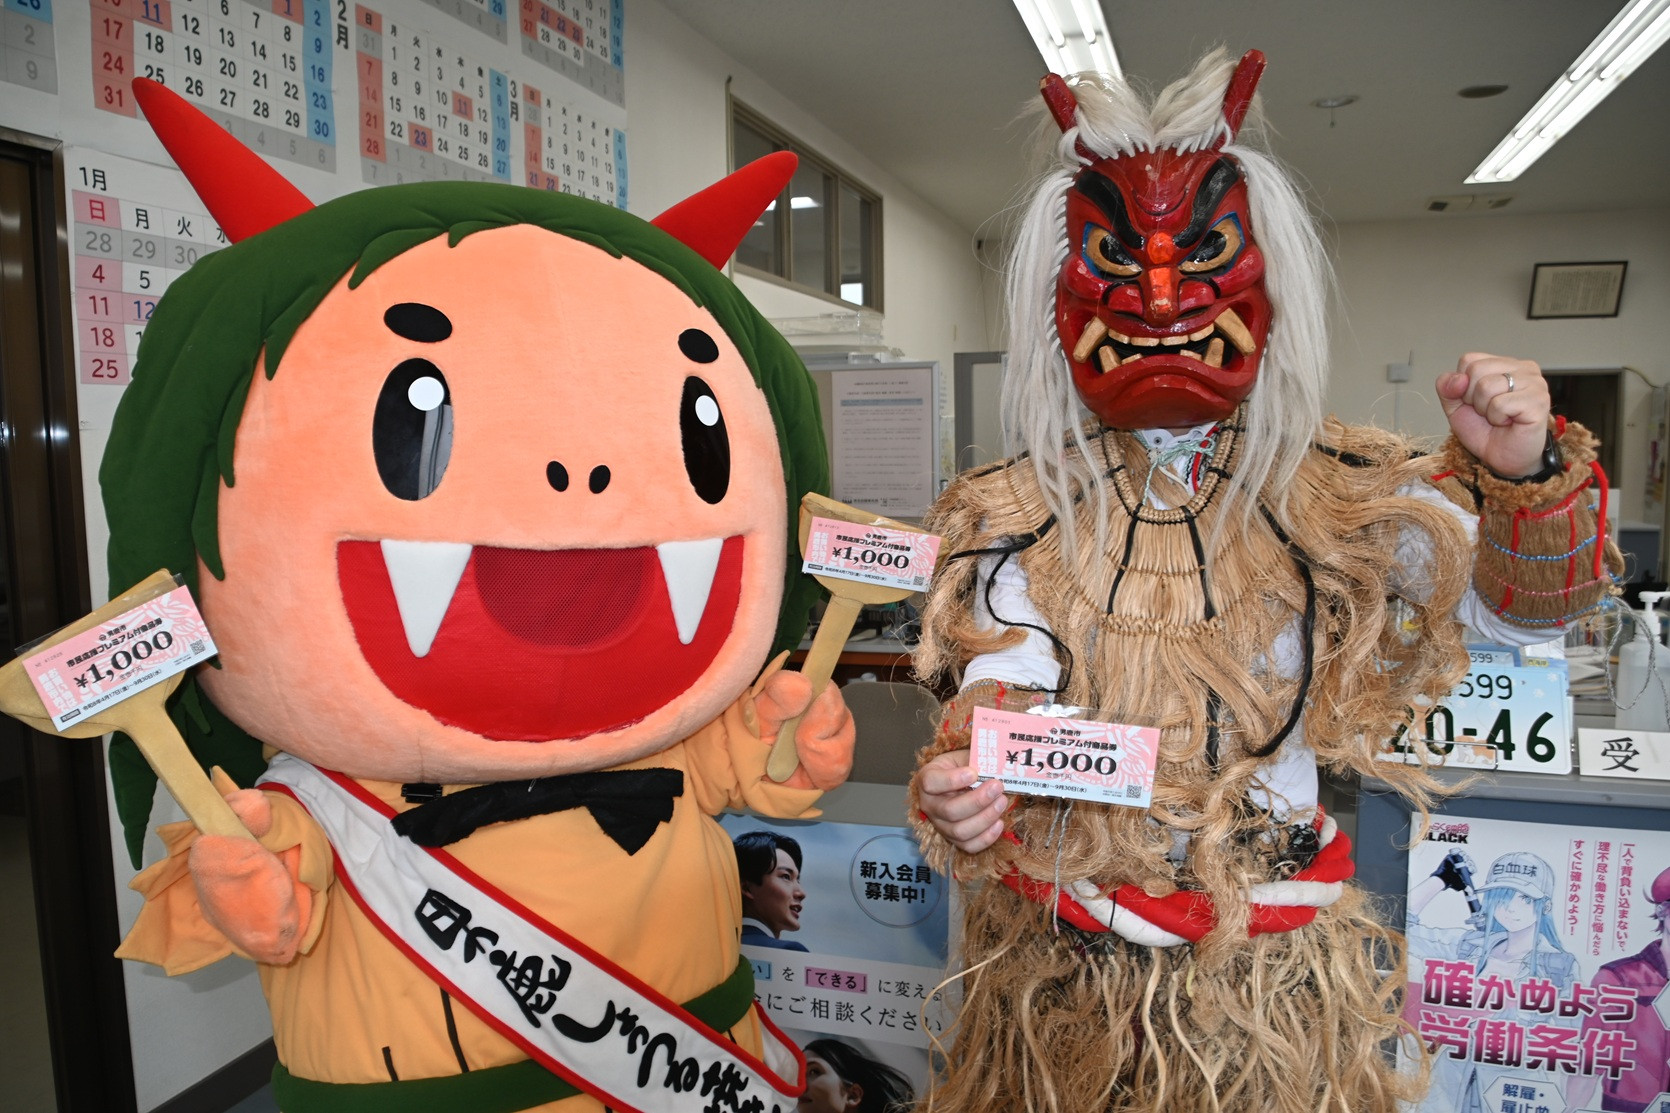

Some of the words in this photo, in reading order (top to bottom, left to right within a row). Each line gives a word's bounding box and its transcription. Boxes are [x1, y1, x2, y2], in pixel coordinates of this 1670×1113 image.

[314, 10, 321, 27] 2
[24, 24, 35, 46] 2
[252, 11, 260, 29] 7
[283, 25, 291, 42] 8
[315, 38, 322, 53] 9
[182, 14, 200, 36] 12
[219, 27, 235, 48] 13
[251, 40, 267, 60] 14
[282, 52, 296, 72] 15
[311, 64, 325, 83] 16
[26, 60, 38, 80] 9
[103, 17, 123, 40] 17
[145, 32, 164, 54] 18
[184, 45, 203, 66] 19
[219, 57, 237, 78] 20
[252, 69, 268, 90] 21
[283, 80, 299, 101] 22
[312, 92, 327, 110] 23
[392, 46, 396, 61] 1
[414, 56, 420, 72] 2
[437, 66, 443, 81] 3
[459, 76, 465, 90] 4
[479, 85, 484, 99] 5
[103, 51, 124, 75] 24
[145, 64, 165, 85] 25
[185, 76, 204, 97] 26
[219, 88, 236, 108] 27
[252, 99, 270, 119] 28
[285, 109, 300, 129] 29
[314, 119, 329, 138] 30
[104, 86, 123, 108] 31
[391, 71, 398, 86] 8
[414, 81, 421, 96] 9
[436, 89, 448, 106] 10
[478, 107, 487, 123] 12
[510, 80, 519, 122] 3月
[390, 95, 402, 113] 15
[413, 105, 426, 122] 16
[437, 113, 448, 129] 17
[459, 122, 469, 137] 18
[479, 130, 488, 145] 19
[563, 123, 568, 136] 2
[365, 112, 377, 129] 21
[390, 121, 403, 138] 22
[414, 128, 427, 147] 23
[437, 138, 449, 154] 24
[458, 146, 469, 161] 25
[478, 153, 489, 168] 26
[366, 138, 379, 155] 28
[546, 157, 555, 170] 15
[562, 163, 571, 176] 16
[577, 169, 585, 182] 17
[591, 175, 599, 188] 18
[606, 181, 614, 193] 19
[577, 149, 585, 162] 10
[591, 155, 598, 168] 11
[604, 162, 612, 175] 12
[79, 166, 107, 191] 1月
[89, 199, 106, 222] 日
[135, 208, 150, 229] 月
[177, 216, 193, 238] 火
[85, 231, 112, 253] 28
[132, 238, 156, 259] 29
[174, 245, 198, 265] 30
[91, 264, 105, 284] 4
[139, 270, 151, 289] 5
[89, 295, 109, 316] 11
[133, 300, 156, 320] 12
[90, 327, 115, 348] 18
[91, 359, 118, 379] 25
[832, 546, 910, 570] ¥1,000
[73, 630, 174, 688] ¥1,000
[1008, 732, 1118, 751] 市民応援プレミアム付商品券
[1059, 729, 1082, 737] 男鹿市
[1005, 748, 1117, 776] ¥1,000
[1600, 737, 1641, 773] 受
[1424, 831, 1469, 845] LACK
[860, 860, 932, 886] 新入会員
[1493, 862, 1538, 878] 白血球
[864, 881, 926, 905] 募集中!
[1592, 841, 1611, 956] 理不尽な働き方に悩んだら
[1421, 958, 1638, 1022] 確かめよう
[1419, 1012, 1637, 1079] 労働条件
